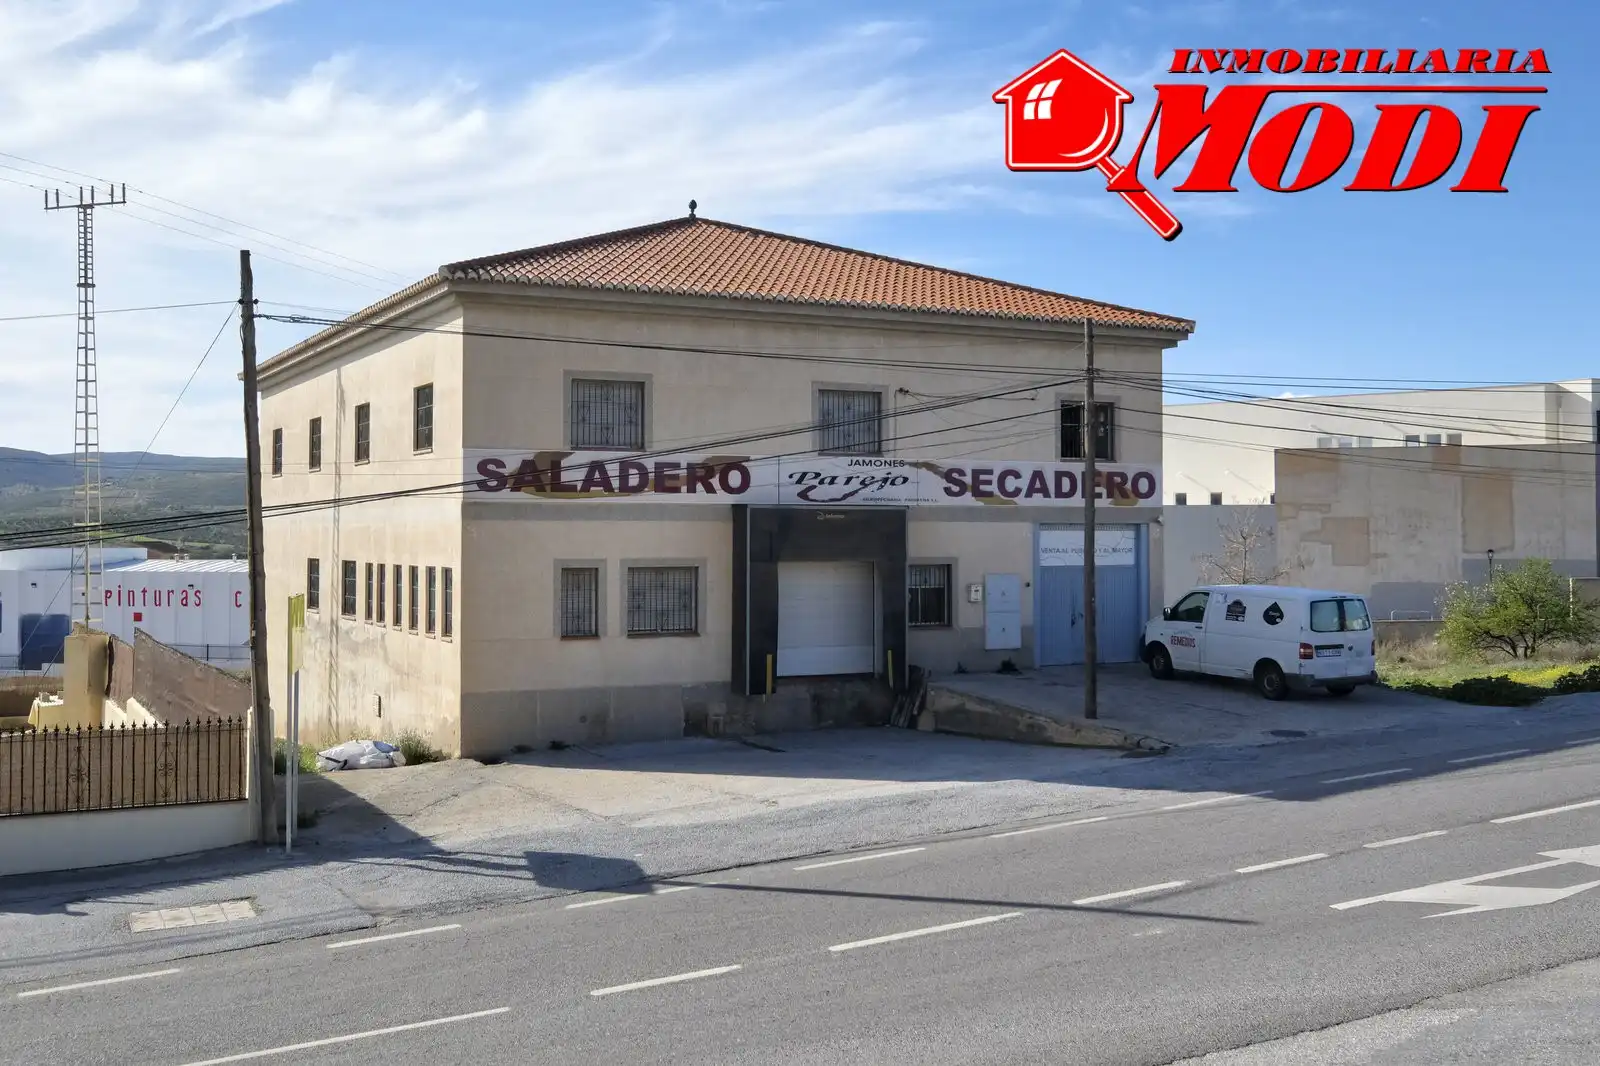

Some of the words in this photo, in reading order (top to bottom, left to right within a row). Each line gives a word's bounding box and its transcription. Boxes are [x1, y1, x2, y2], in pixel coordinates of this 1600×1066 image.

[476, 458, 751, 495] SALADERO
[847, 459, 905, 468] JAMONES
[788, 471, 909, 496] Parejo
[942, 467, 1157, 499] SECADERO
